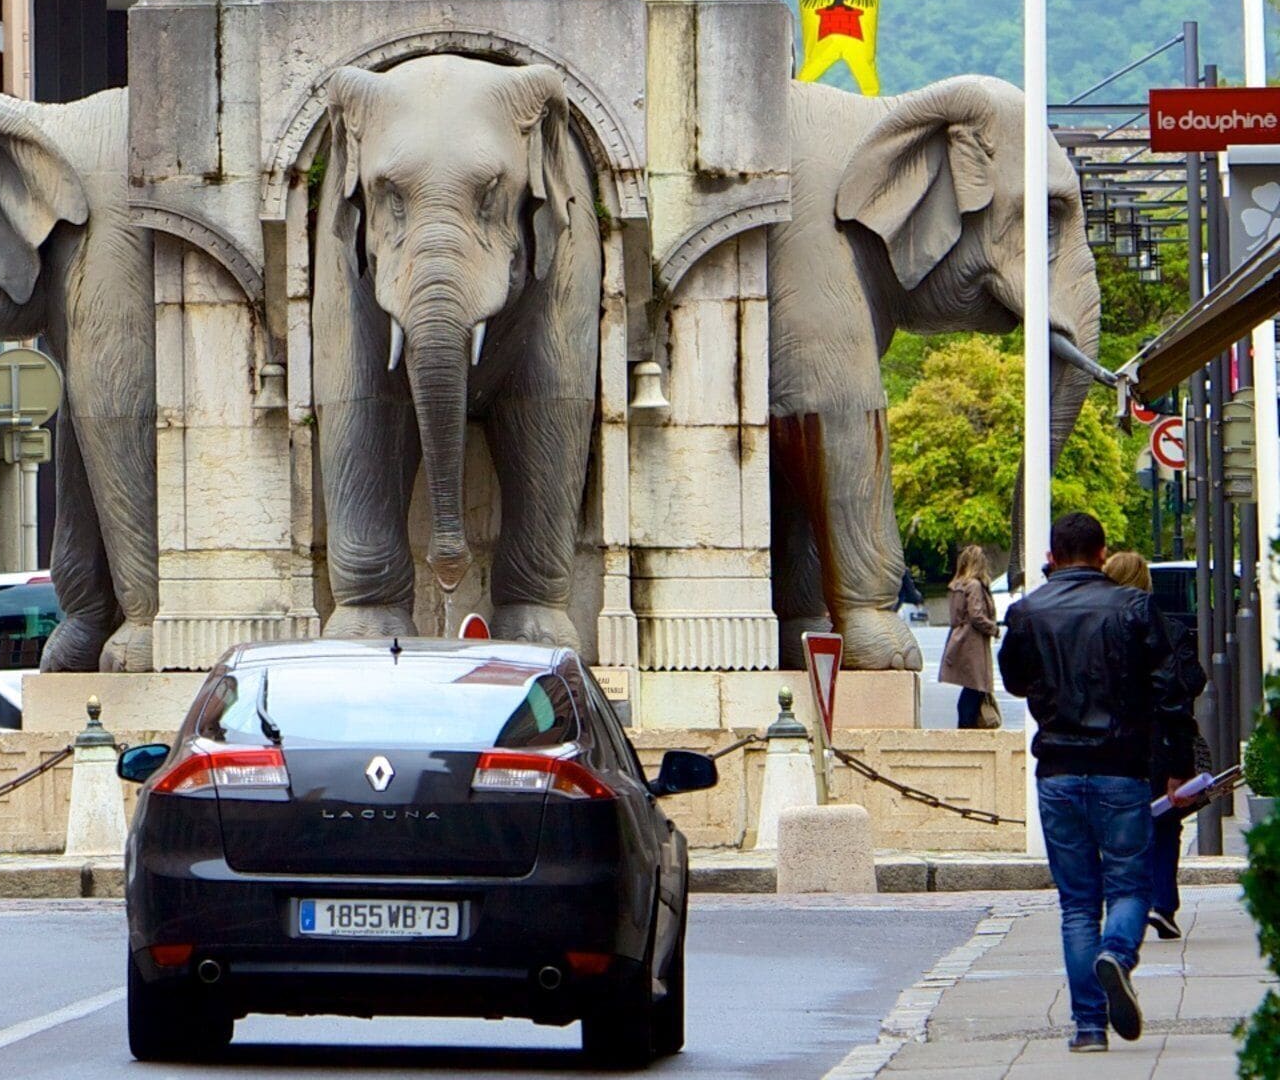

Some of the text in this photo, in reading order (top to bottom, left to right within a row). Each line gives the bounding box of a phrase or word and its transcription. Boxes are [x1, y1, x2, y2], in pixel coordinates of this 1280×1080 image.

[1157, 110, 1176, 130] le
[326, 904, 450, 930] 1855 WB 73
